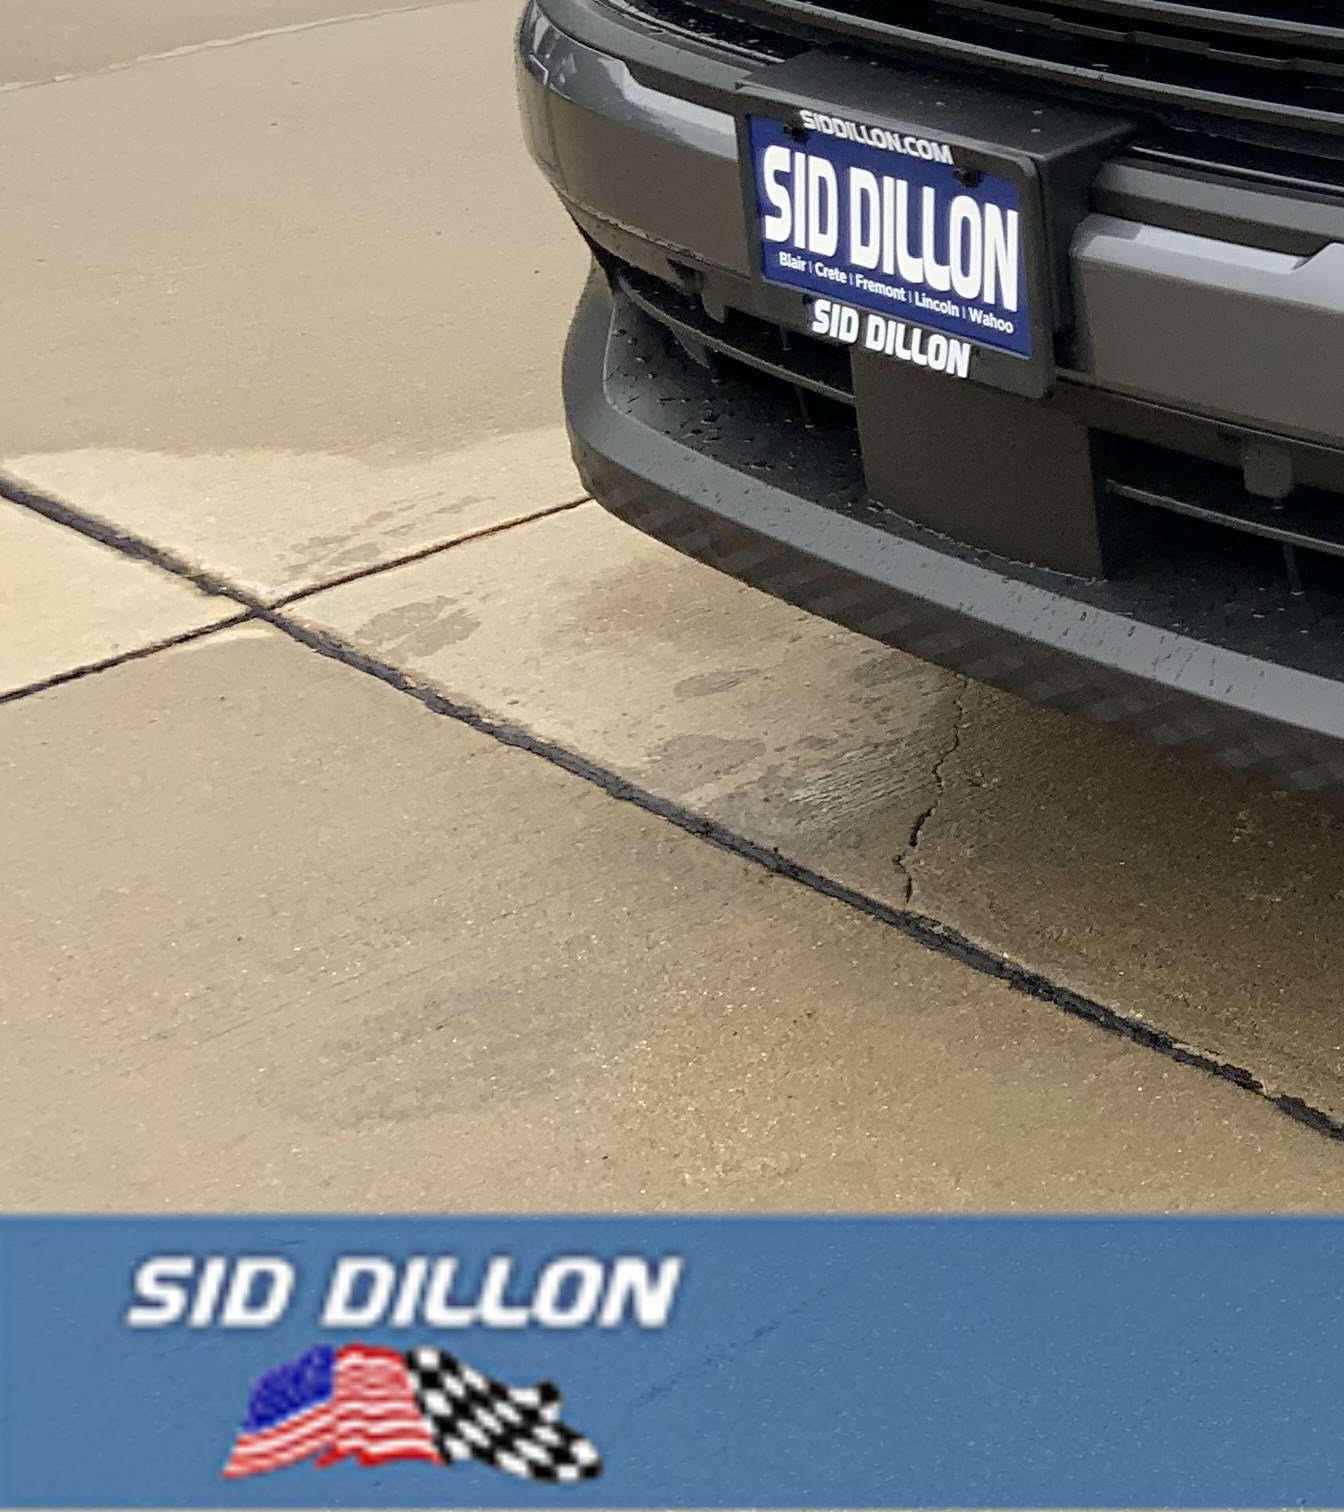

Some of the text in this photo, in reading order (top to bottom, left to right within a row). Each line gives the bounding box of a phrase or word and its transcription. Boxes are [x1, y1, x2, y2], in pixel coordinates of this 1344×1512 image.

[800, 109, 955, 166] SIDDILLON.COM
[763, 144, 1019, 313] SID DILLON
[779, 250, 1014, 335] Blair Crete Fremont Lincoln Wahoo
[811, 298, 972, 379] SID DILLON
